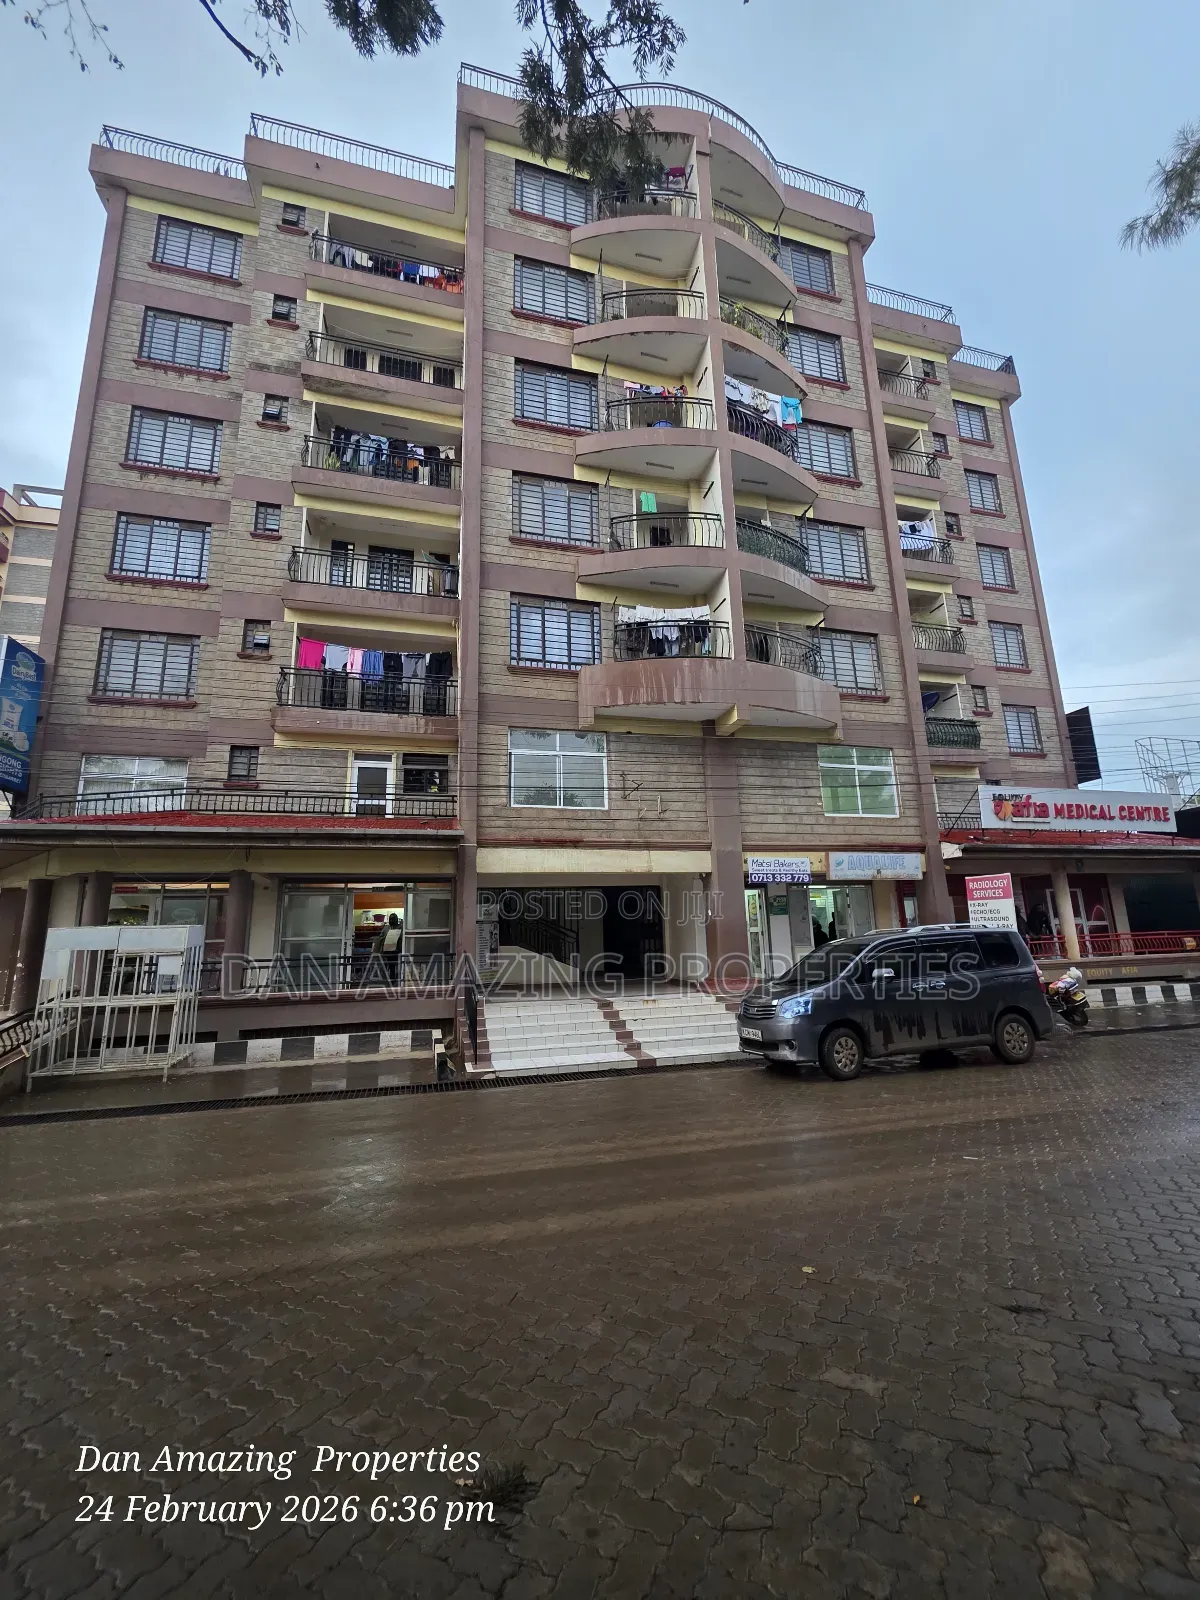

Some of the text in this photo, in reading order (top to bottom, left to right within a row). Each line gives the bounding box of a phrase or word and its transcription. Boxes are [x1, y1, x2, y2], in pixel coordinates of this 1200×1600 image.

[1053, 803, 1116, 820] MEDICAL
[1118, 805, 1171, 822] CENTRE
[751, 859, 772, 868] Matsi
[848, 855, 906, 871] AQUALIFE
[969, 879, 1008, 890] RADIOLOGY
[973, 889, 1004, 898] SERVICES
[1087, 967, 1139, 977] EQUITY AFIA
